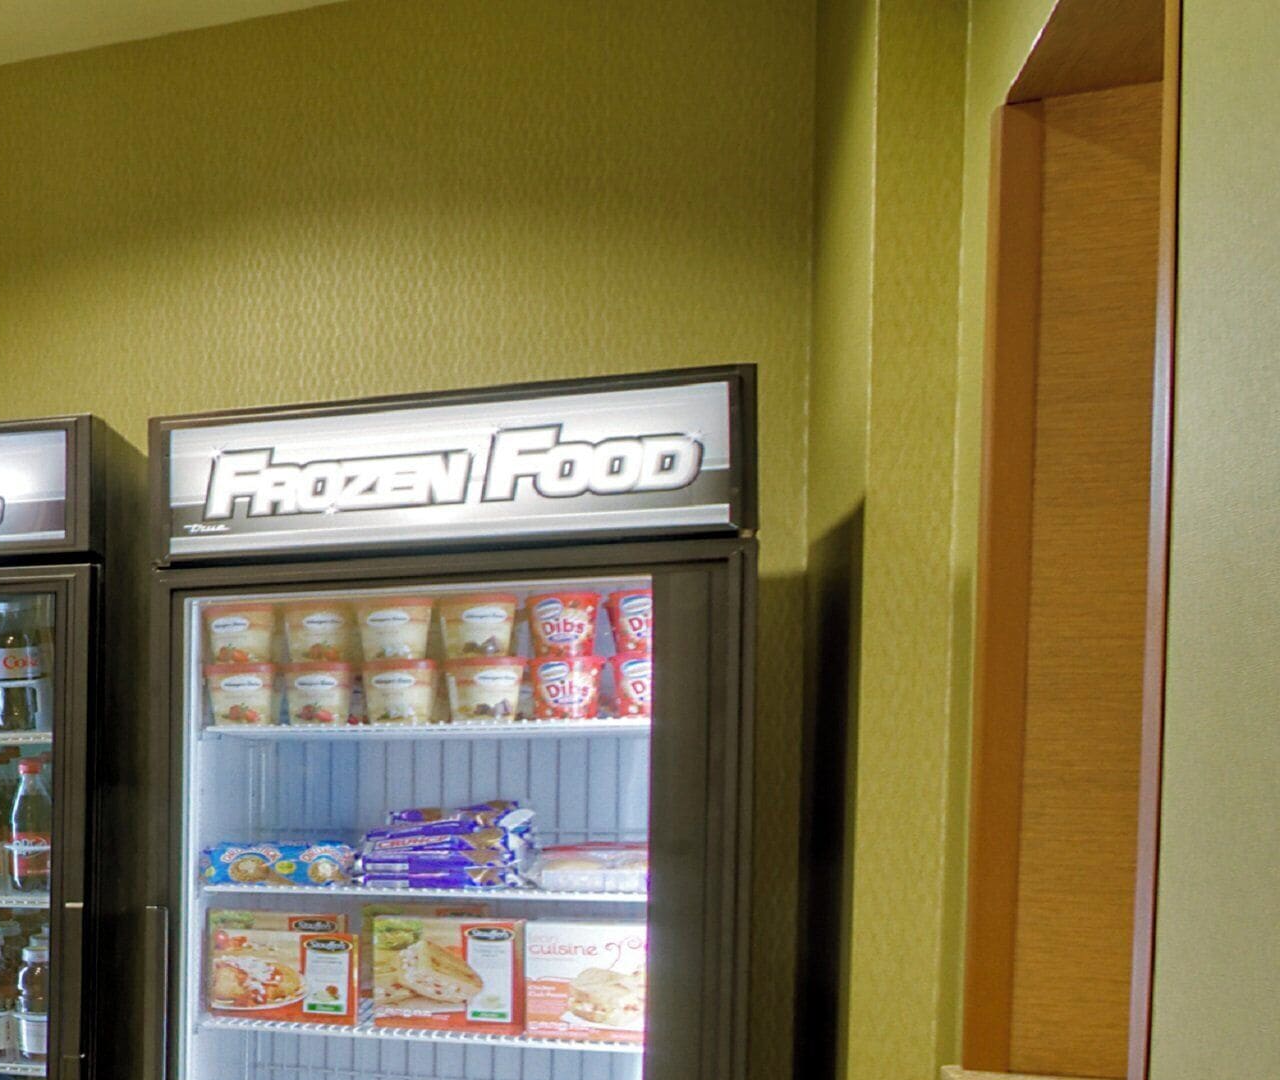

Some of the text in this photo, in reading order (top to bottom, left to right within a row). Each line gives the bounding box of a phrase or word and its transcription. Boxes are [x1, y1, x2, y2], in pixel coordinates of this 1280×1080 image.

[202, 423, 704, 521] FROZEN FOOD
[184, 522, 229, 533] true
[542, 617, 585, 636] Dibs
[629, 612, 652, 632] Di
[3, 654, 39, 670] Coke
[528, 943, 598, 957] cuisine
